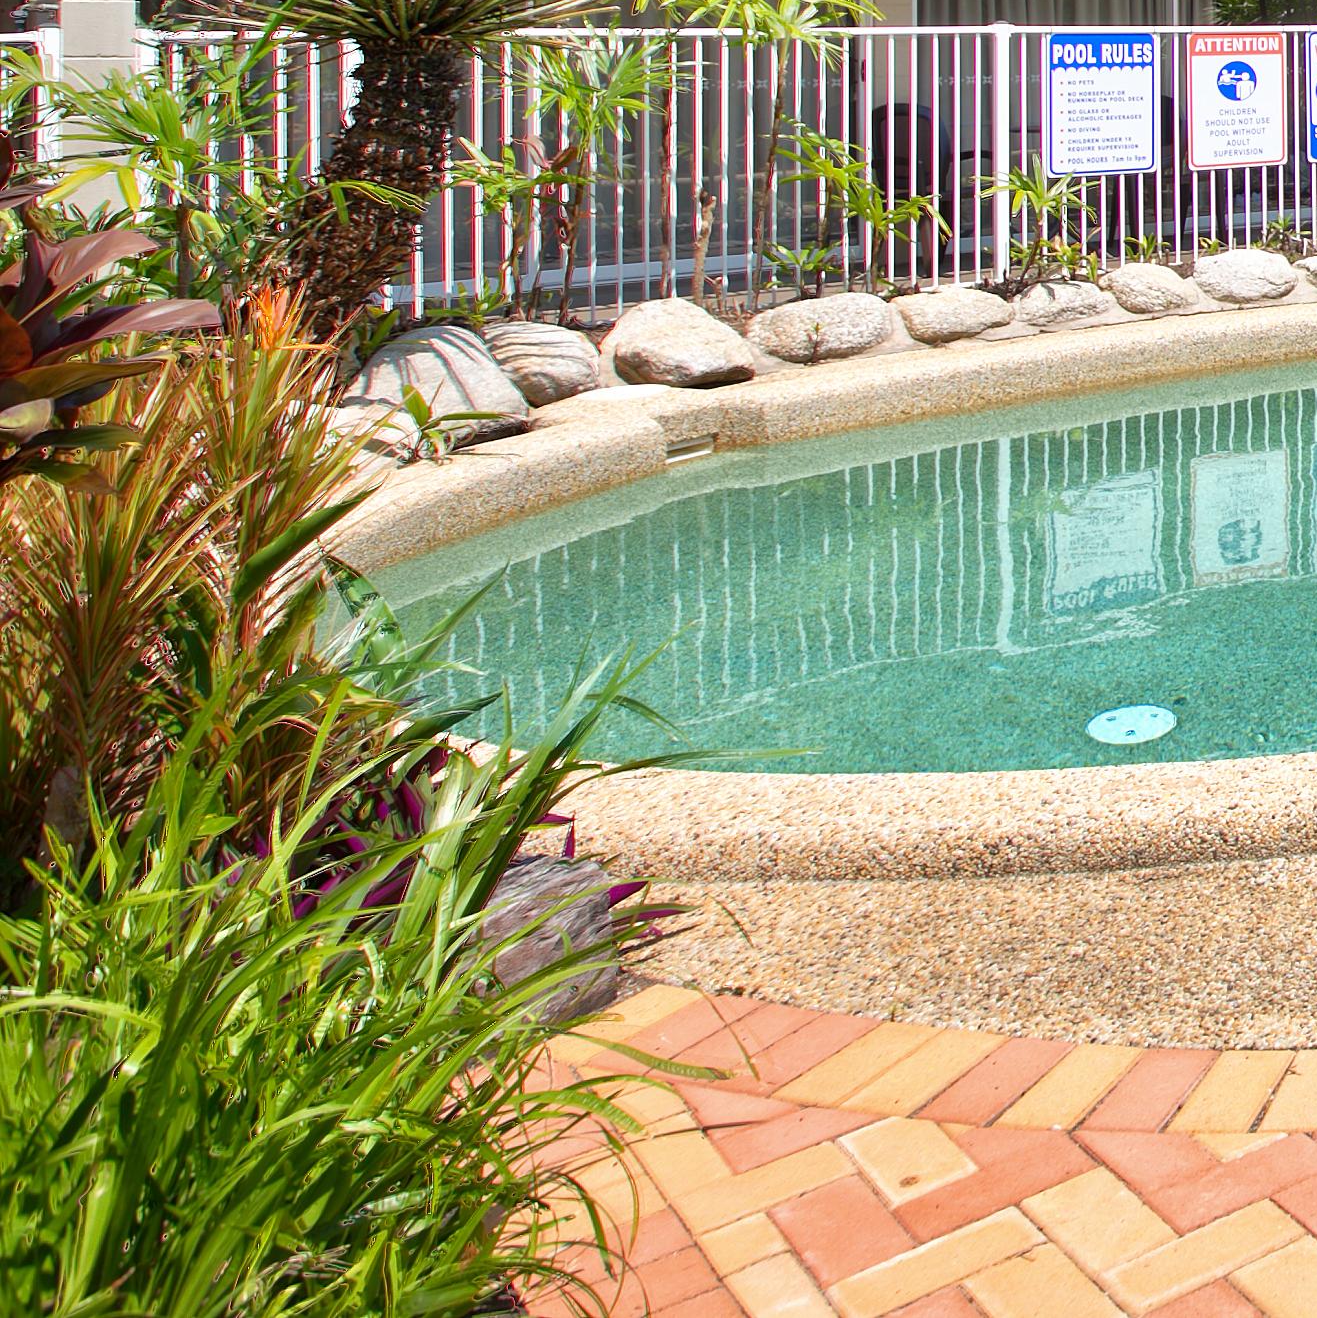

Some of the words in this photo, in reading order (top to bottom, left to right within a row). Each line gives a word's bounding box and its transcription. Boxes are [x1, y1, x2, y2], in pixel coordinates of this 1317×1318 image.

[1194, 37, 1279, 52] ATTENTION
[1052, 43, 1096, 64] POOL
[1101, 43, 1152, 63] RULES
[1219, 108, 1257, 116] CHILDREN
[1205, 119, 1236, 127] SHOULD
[1233, 128, 1265, 136] WITHOUT
[1213, 148, 1264, 157] SUPERVISION
